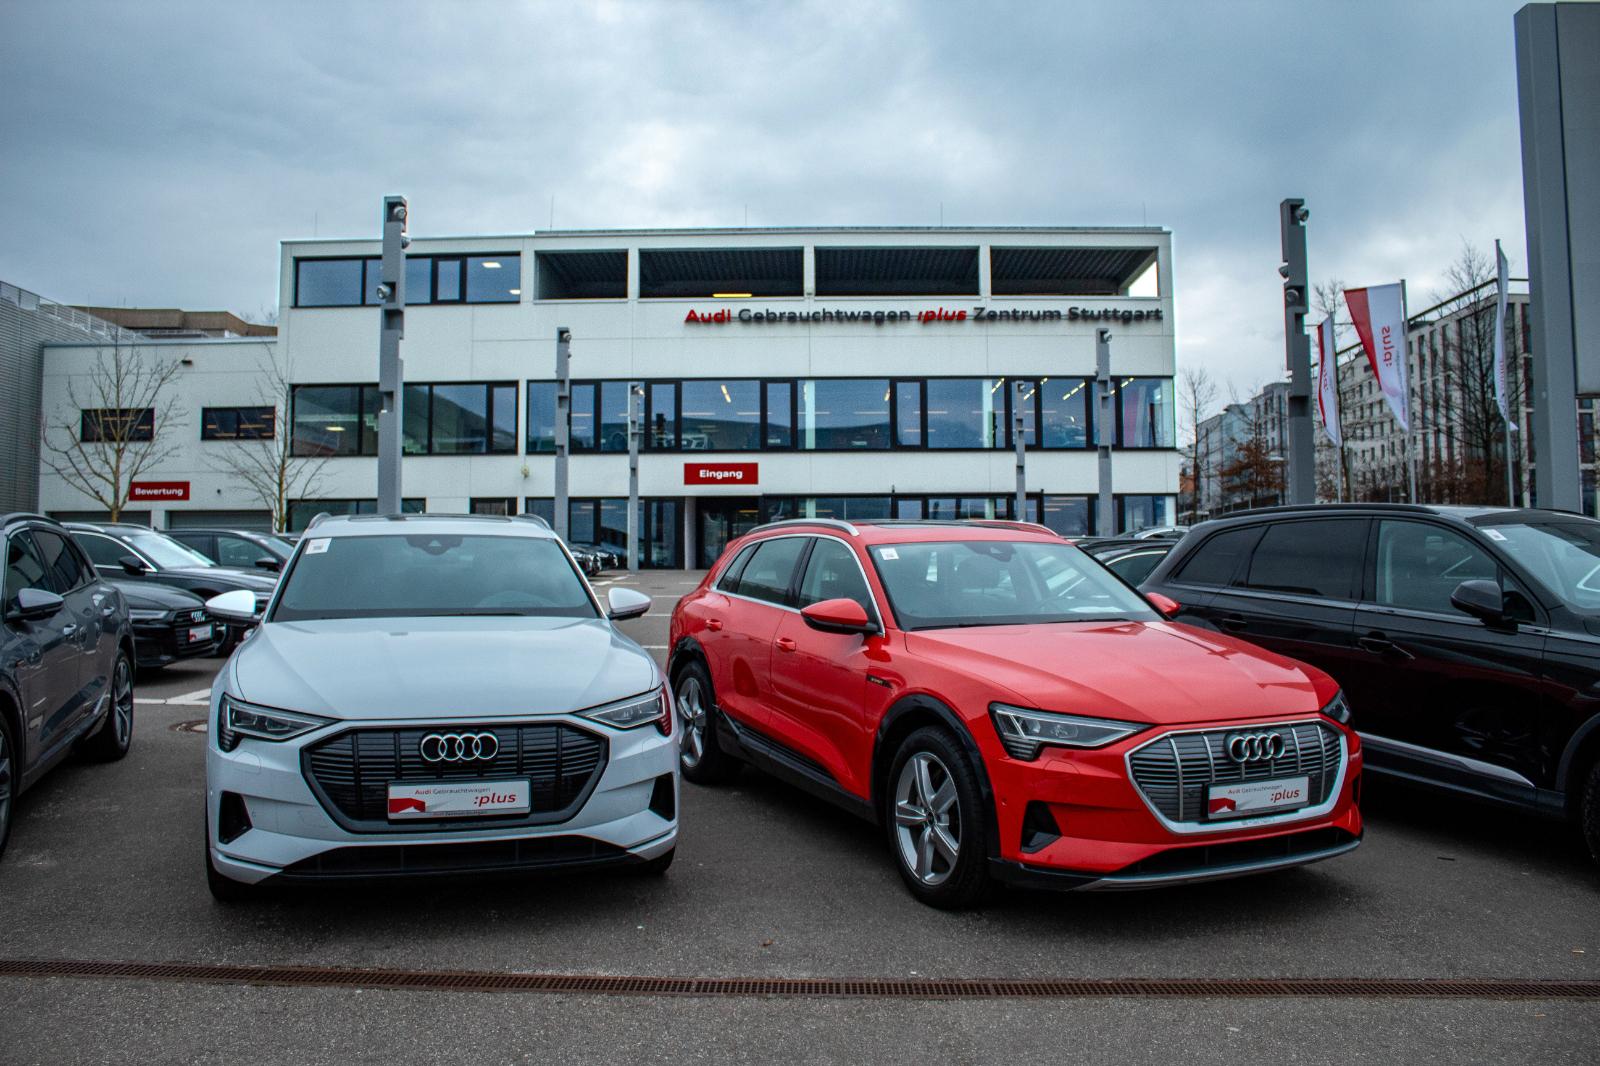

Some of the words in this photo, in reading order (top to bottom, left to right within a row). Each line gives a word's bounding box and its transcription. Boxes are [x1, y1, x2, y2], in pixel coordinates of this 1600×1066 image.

[684, 308, 732, 323] Audi
[738, 308, 911, 325] Gebrauchtwagen
[973, 307, 1062, 321] Zentrum
[1068, 307, 1163, 324] Stuttgart
[699, 469, 743, 480] Eingang
[135, 487, 184, 497] Bewertung
[414, 788, 432, 796] Audi
[1270, 788, 1300, 803] :plus
[473, 792, 517, 807] :plus
